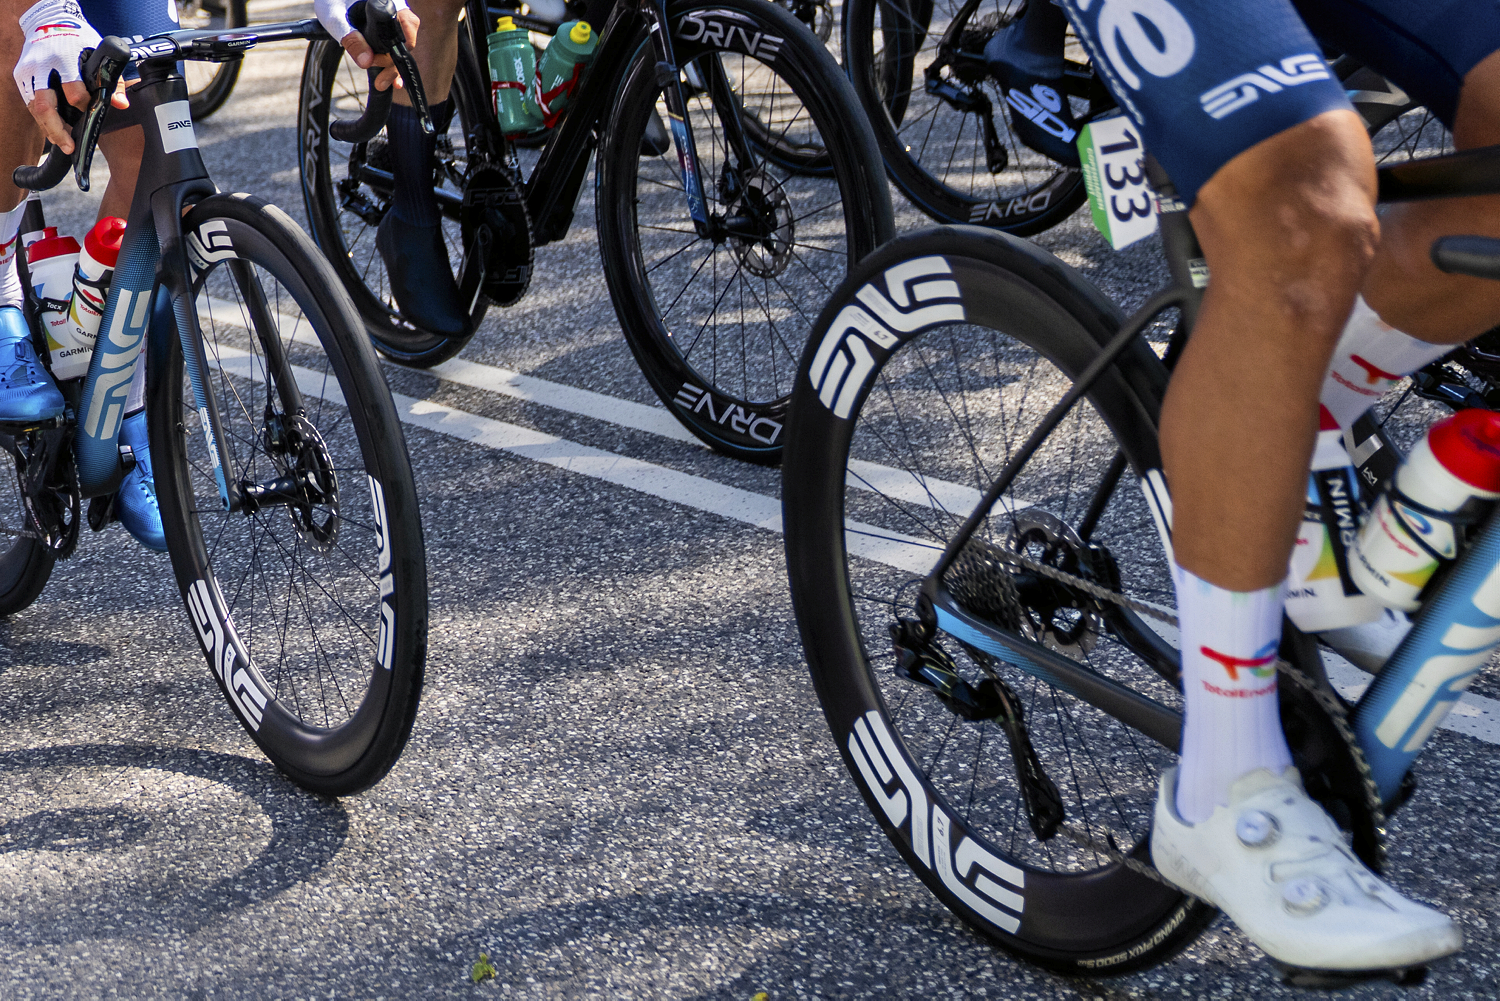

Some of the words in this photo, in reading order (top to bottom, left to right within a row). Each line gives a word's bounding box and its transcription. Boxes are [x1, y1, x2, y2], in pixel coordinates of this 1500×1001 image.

[227, 39, 251, 48] GARMIN
[673, 9, 785, 62] DRIVE
[1099, 128, 1152, 223] 133
